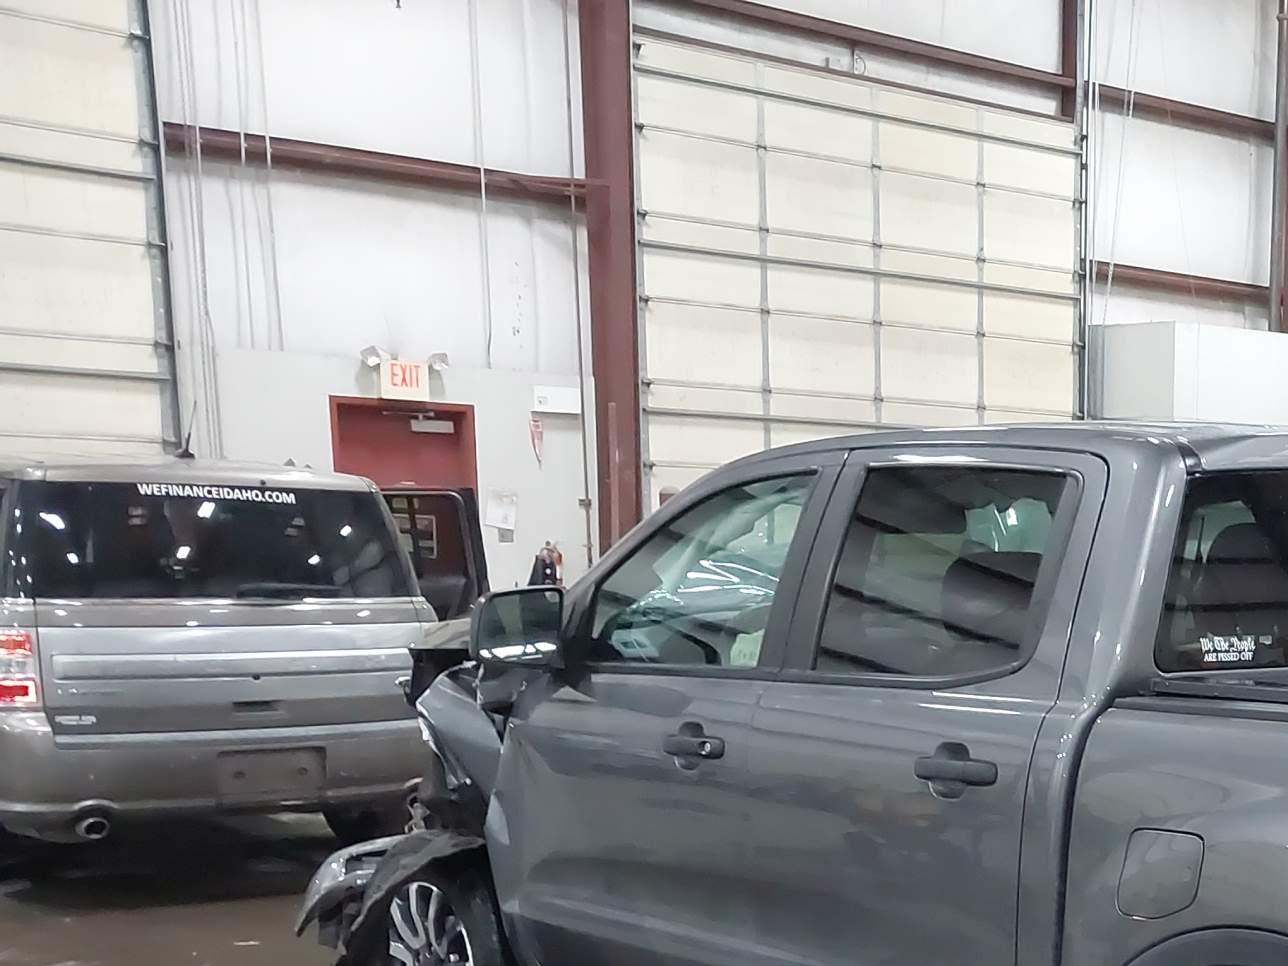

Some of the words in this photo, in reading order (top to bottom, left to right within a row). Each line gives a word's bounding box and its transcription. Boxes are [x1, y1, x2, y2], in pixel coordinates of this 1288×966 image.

[391, 363, 421, 388] EXIT
[136, 483, 296, 504] WEFINANCEIDAHO.COM
[1200, 637, 1214, 653] We
[1214, 637, 1229, 651] The
[1230, 636, 1255, 653] People
[1204, 653, 1217, 661] ARE
[1218, 652, 1240, 661] PISSED
[1240, 652, 1253, 661] OFF
